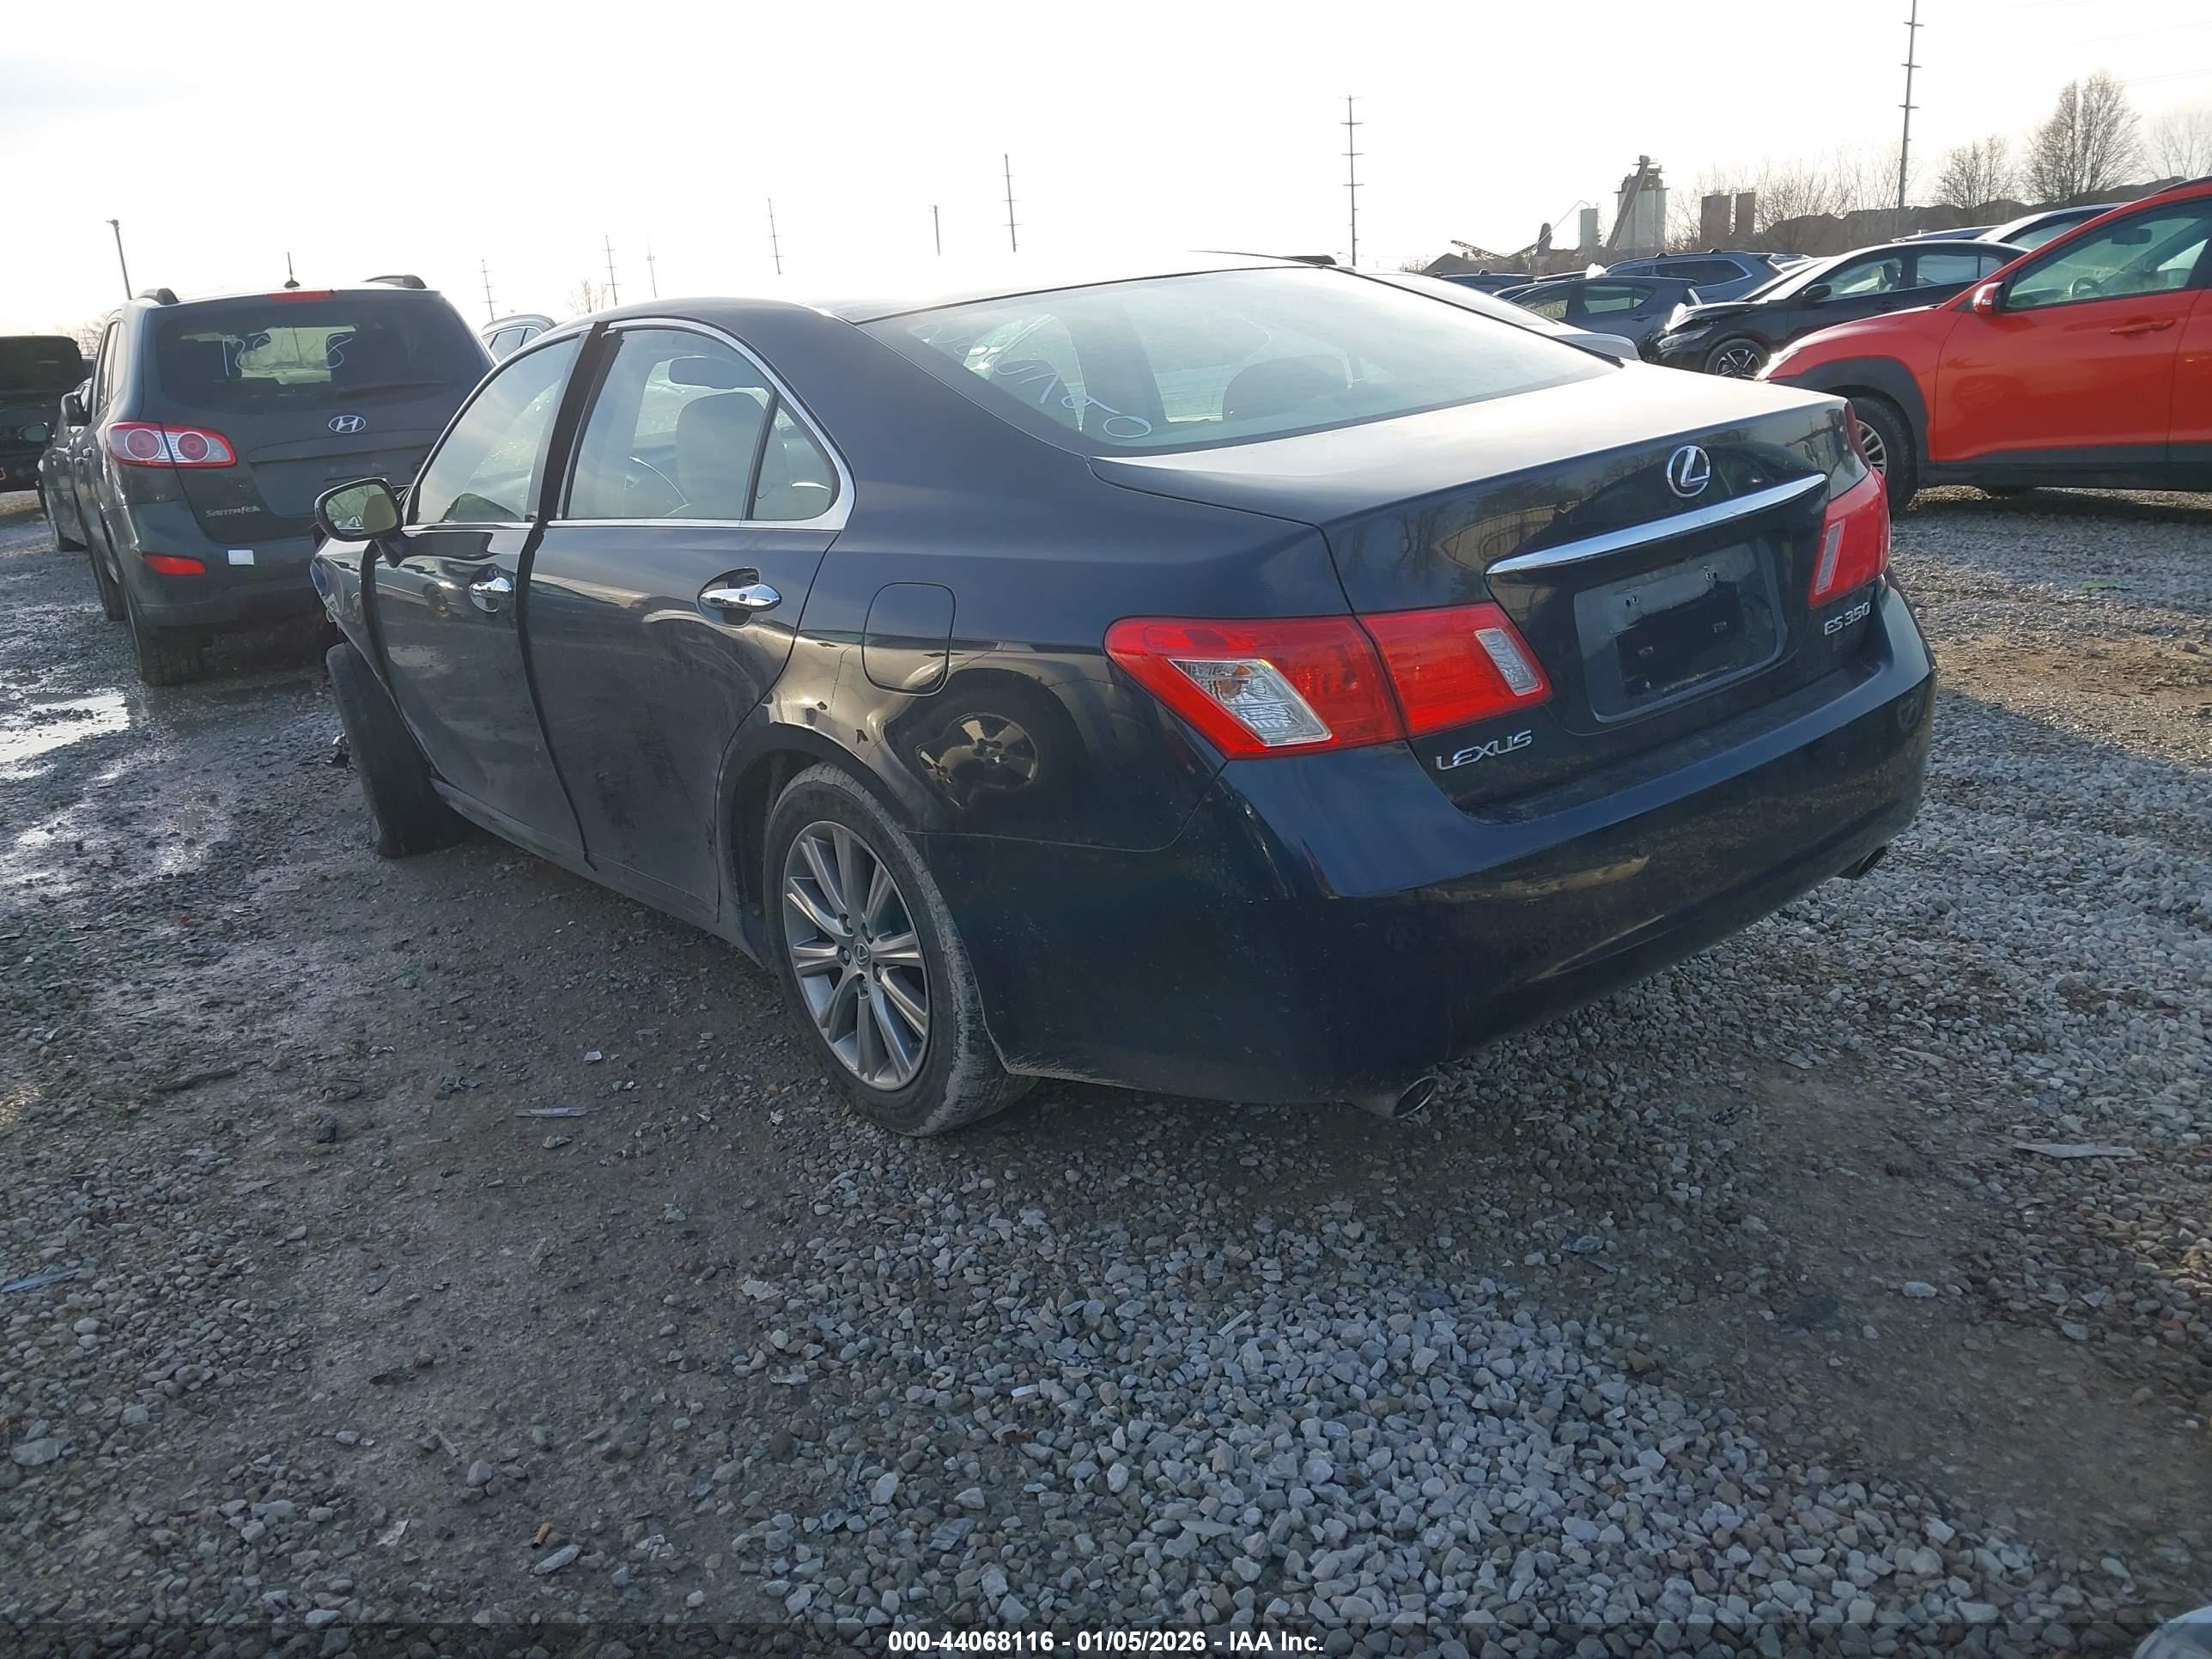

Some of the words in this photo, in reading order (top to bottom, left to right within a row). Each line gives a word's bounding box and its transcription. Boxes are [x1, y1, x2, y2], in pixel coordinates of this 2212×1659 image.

[1824, 616, 1844, 636] ES
[1844, 601, 1871, 626] 350
[1436, 730, 1533, 770] LEXUS
